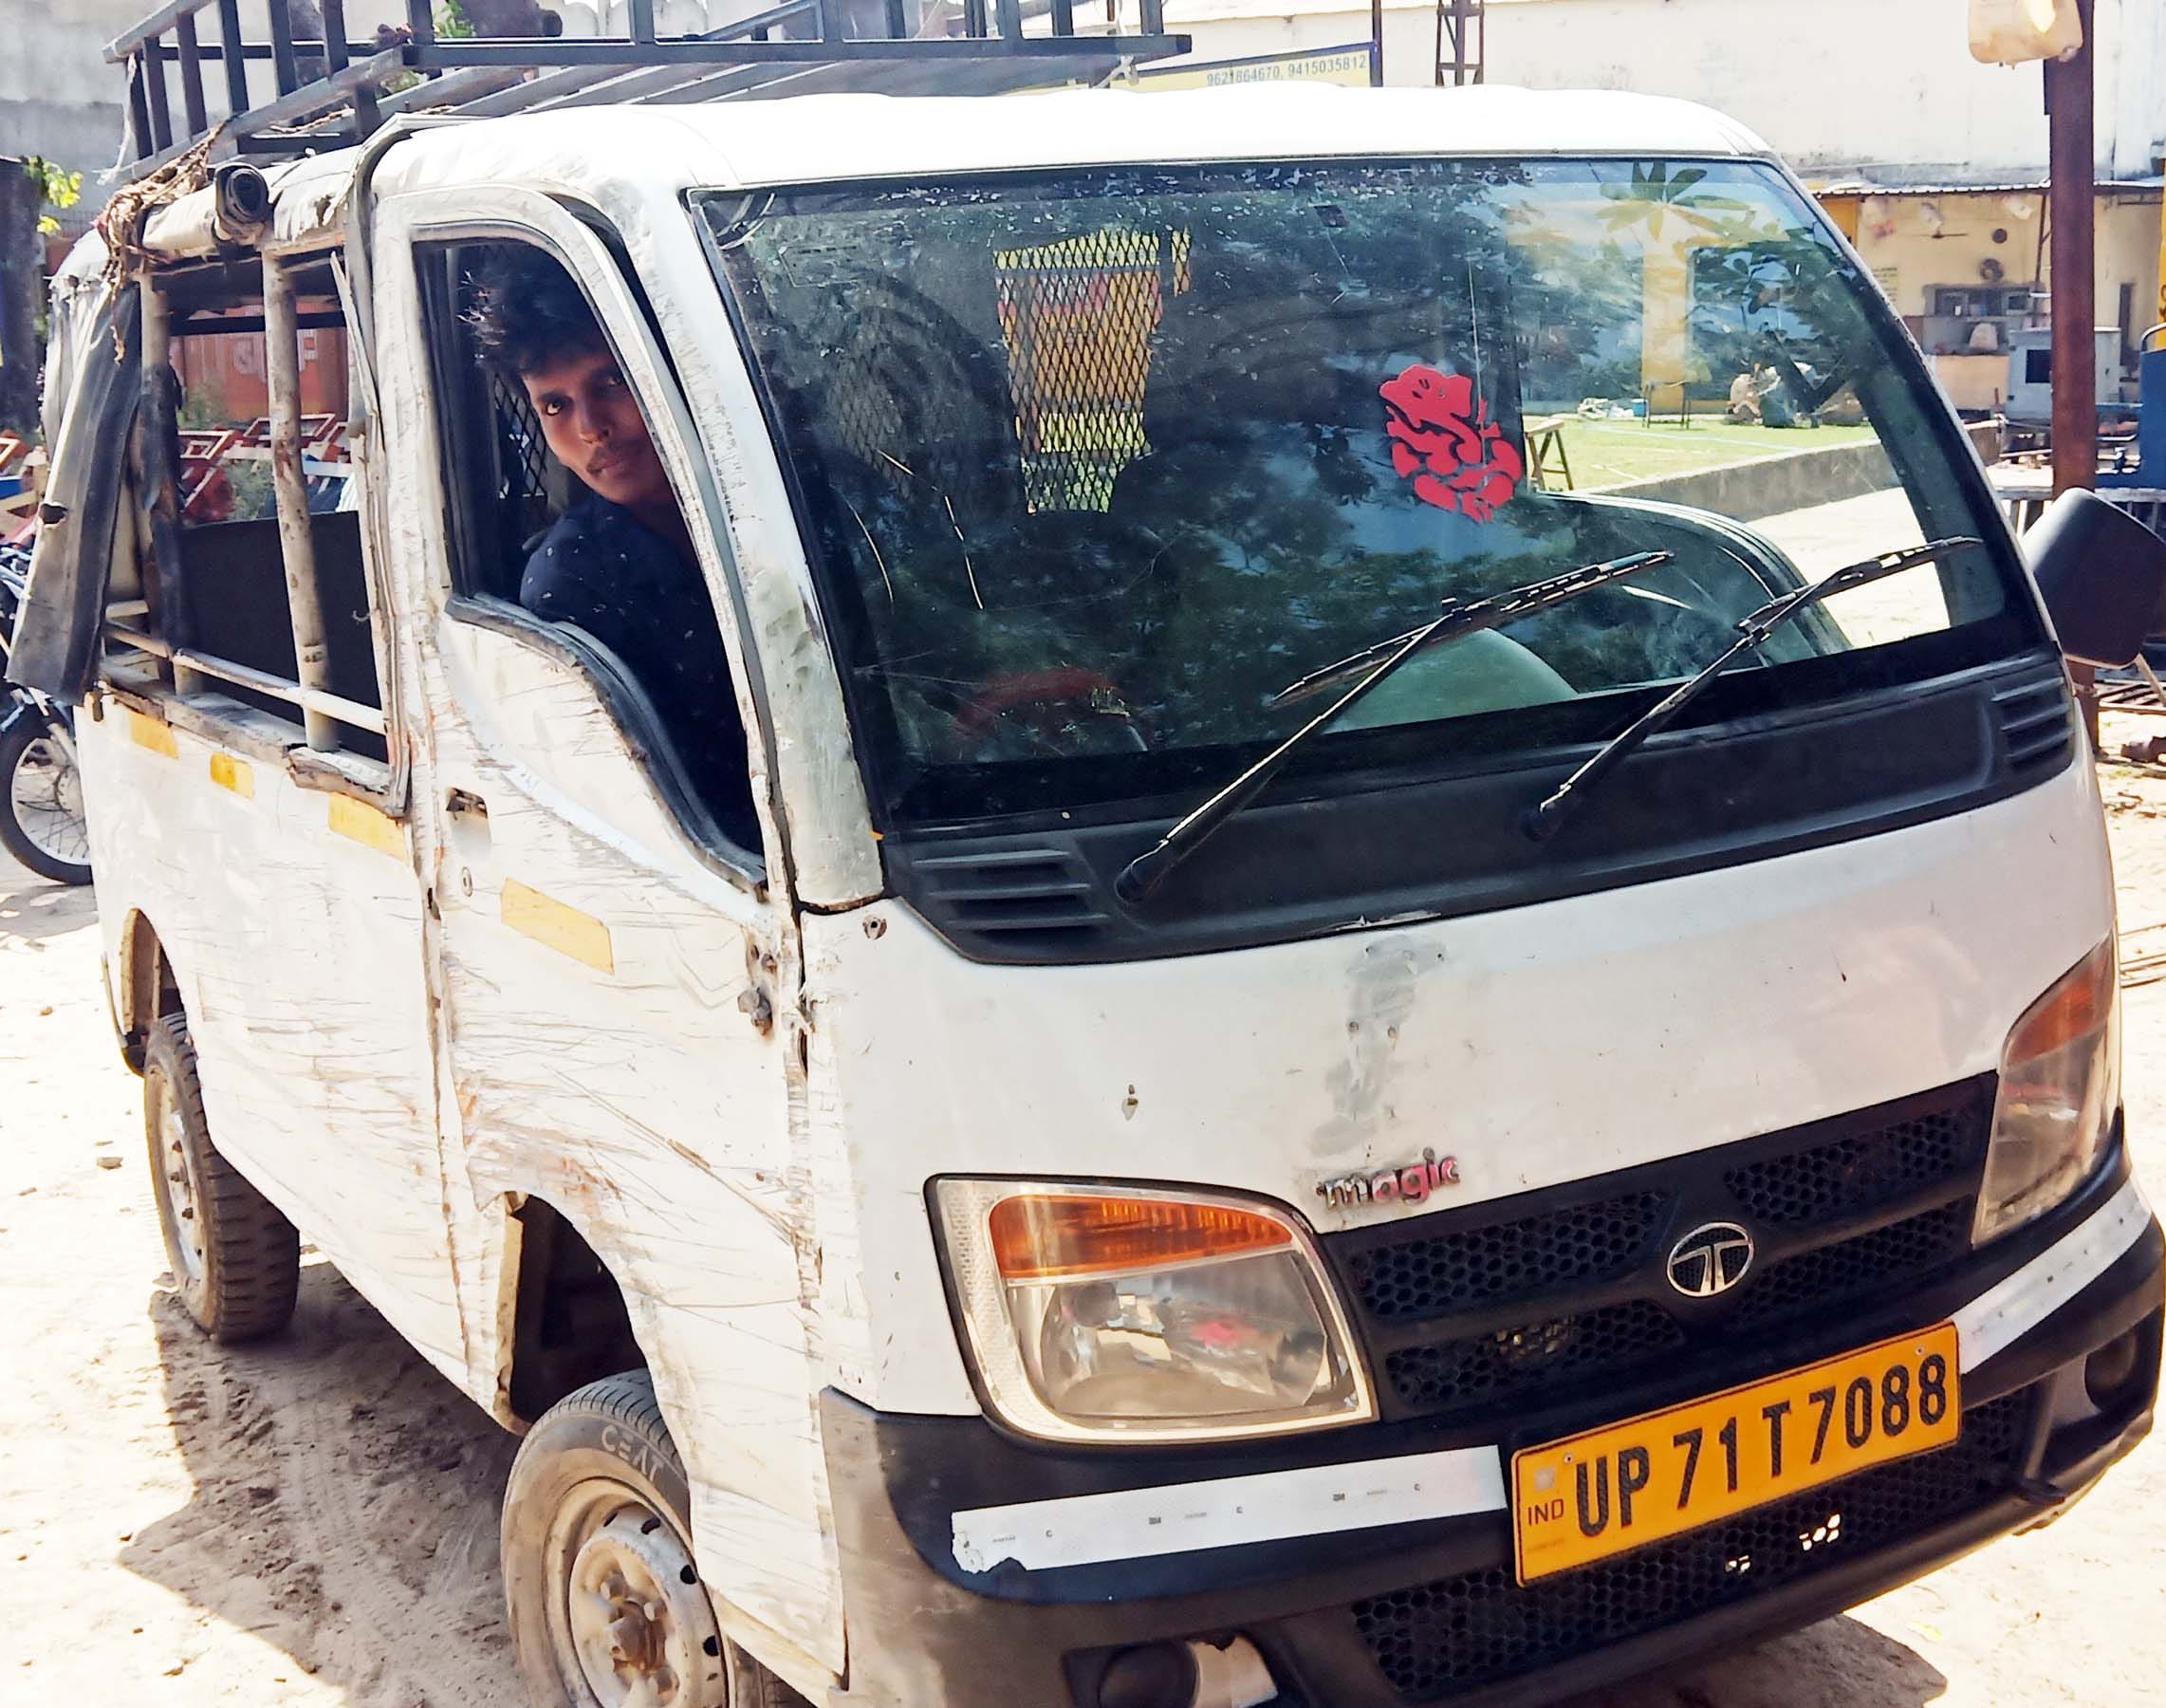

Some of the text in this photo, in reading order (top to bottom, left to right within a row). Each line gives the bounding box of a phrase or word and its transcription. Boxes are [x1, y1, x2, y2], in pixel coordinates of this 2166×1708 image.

[1287, 54, 1367, 78] 9415035812
[1324, 1146, 1461, 1210] magic
[1527, 1498, 1564, 1527] IND
